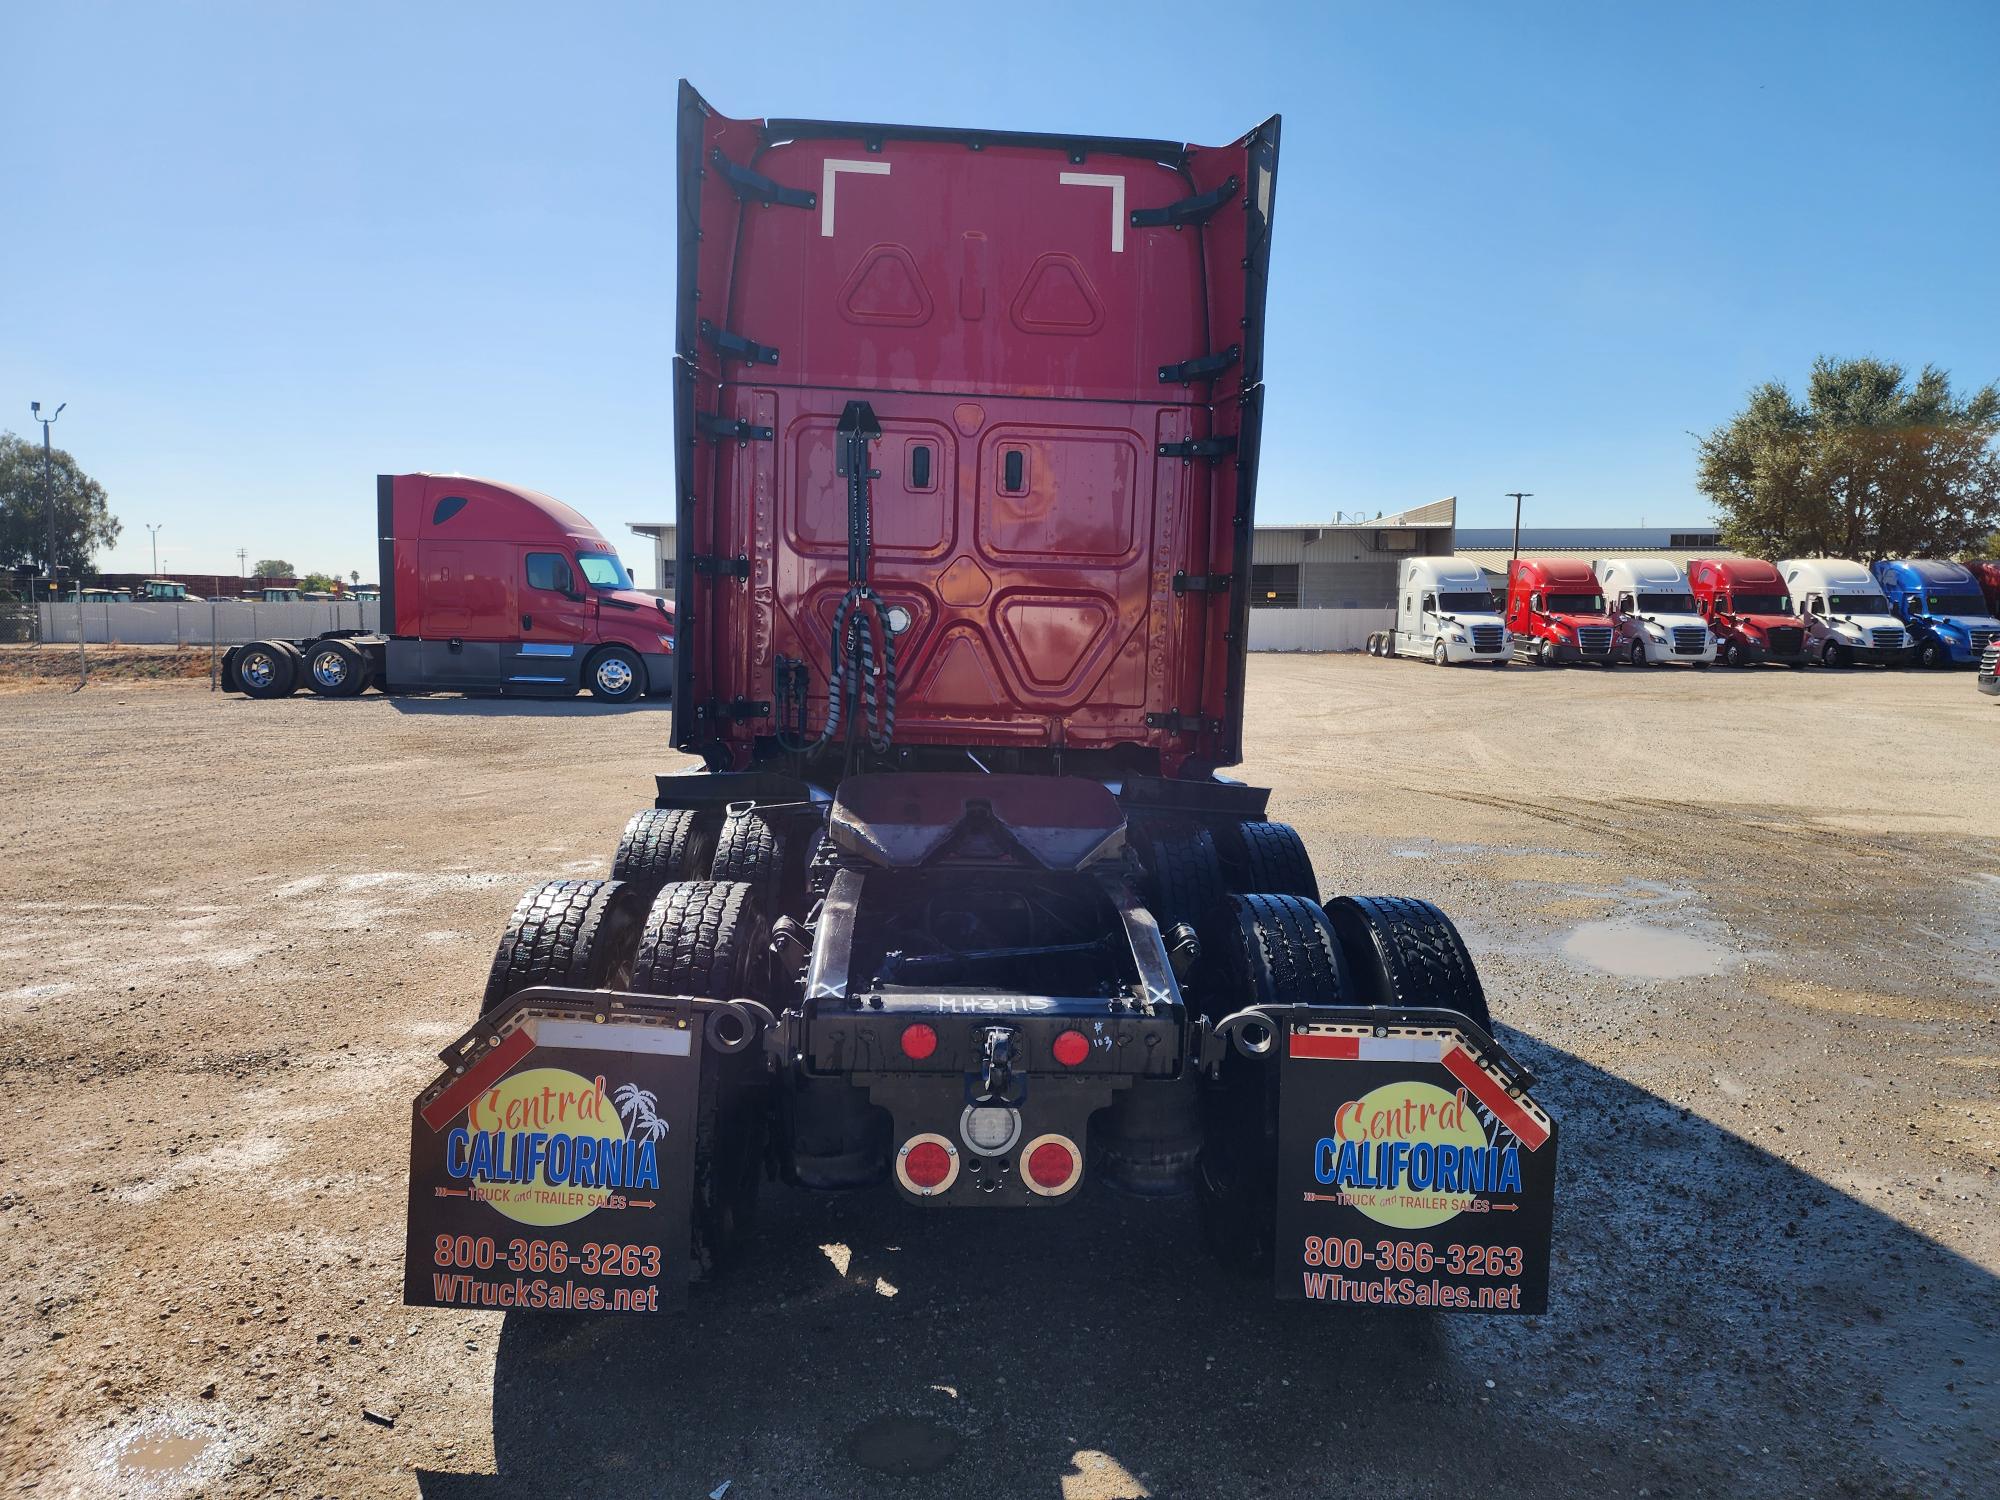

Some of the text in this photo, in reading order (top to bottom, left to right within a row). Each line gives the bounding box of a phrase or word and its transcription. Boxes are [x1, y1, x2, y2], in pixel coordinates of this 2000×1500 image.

[468, 1074, 607, 1136] Central
[1334, 1087, 1469, 1145] Central
[447, 1127, 660, 1190] CALIFORNIA
[1314, 1137, 1523, 1194] CALIFORNIA
[468, 1186, 510, 1203] TRUCK
[534, 1190, 584, 1207] TRAILER
[587, 1194, 627, 1210] SALES
[1335, 1192, 1376, 1207] TRUCK
[1400, 1196, 1448, 1211] TRAILER
[1451, 1199, 1491, 1213] SALES
[433, 1234, 662, 1278] 800-366-3263
[1303, 1235, 1524, 1277] 800-366-3263
[432, 1272, 659, 1312] WTruckSales.net
[1303, 1271, 1522, 1309] WTruckSales.net
